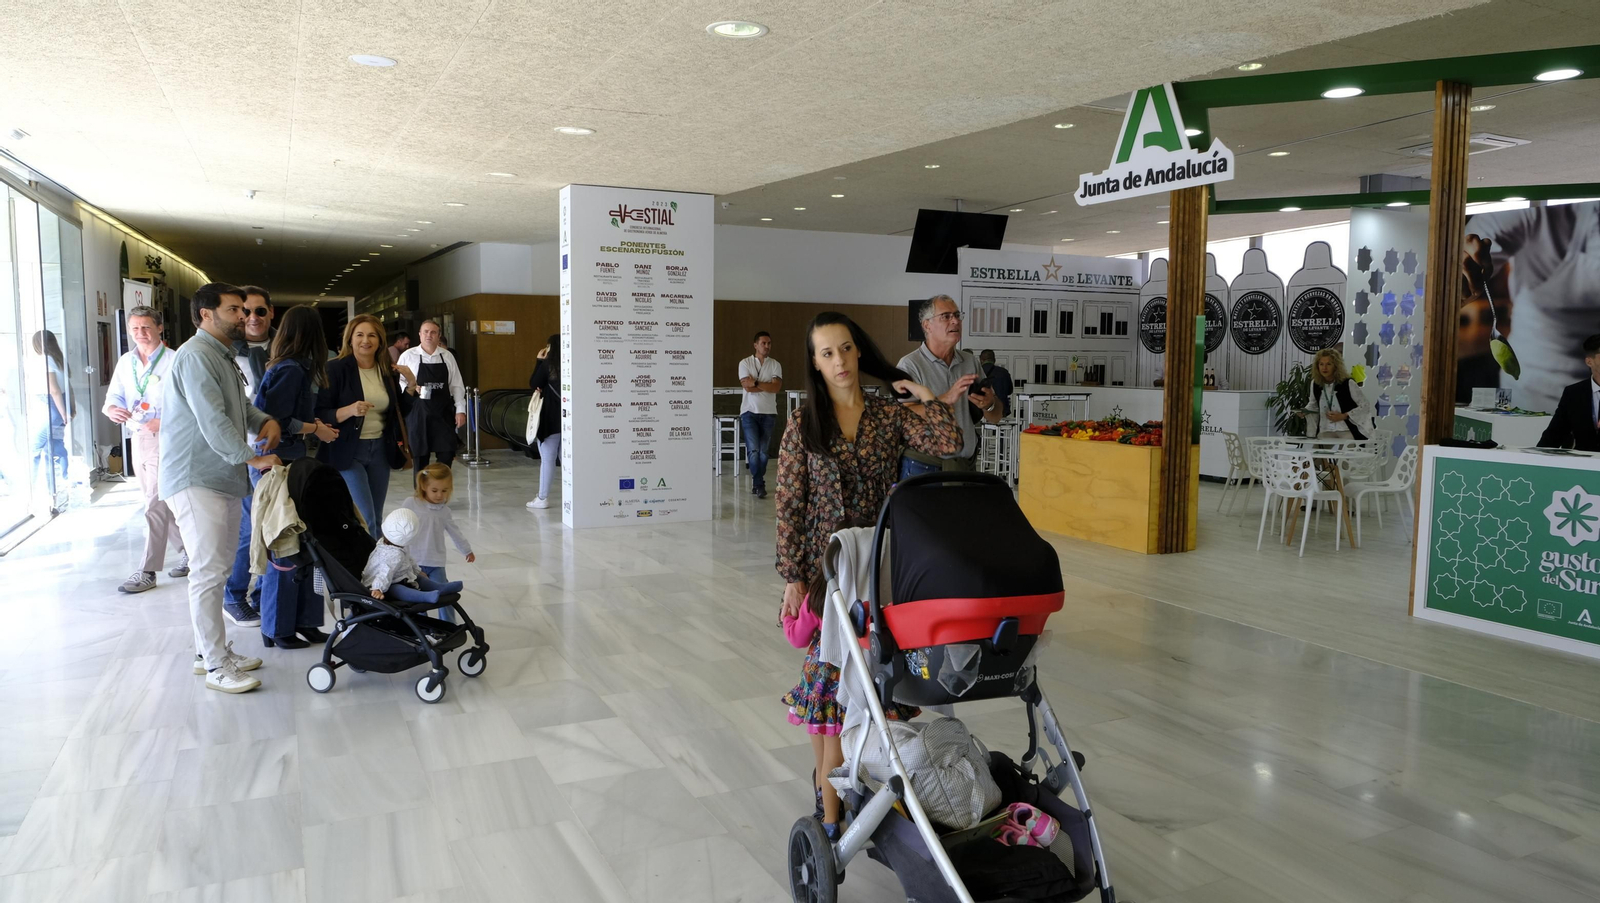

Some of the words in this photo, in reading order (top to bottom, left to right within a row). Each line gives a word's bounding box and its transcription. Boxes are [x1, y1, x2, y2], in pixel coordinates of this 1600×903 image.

[1079, 176, 1120, 199] Junta
[1122, 171, 1142, 191] de
[1144, 150, 1228, 187] Andalucía
[620, 241, 666, 249] PONENTES
[600, 246, 650, 254] ESCENARIO
[970, 266, 1041, 282] ESTRELLA
[1062, 276, 1074, 284] DE
[1076, 273, 1133, 286] LEVANTE
[1233, 320, 1277, 328] ESTRELLA
[1292, 318, 1341, 327] ESTRELLA
[1542, 574, 1559, 585] del
[1559, 569, 1600, 595] Sur
[984, 672, 1015, 681] MAXI-COSI
